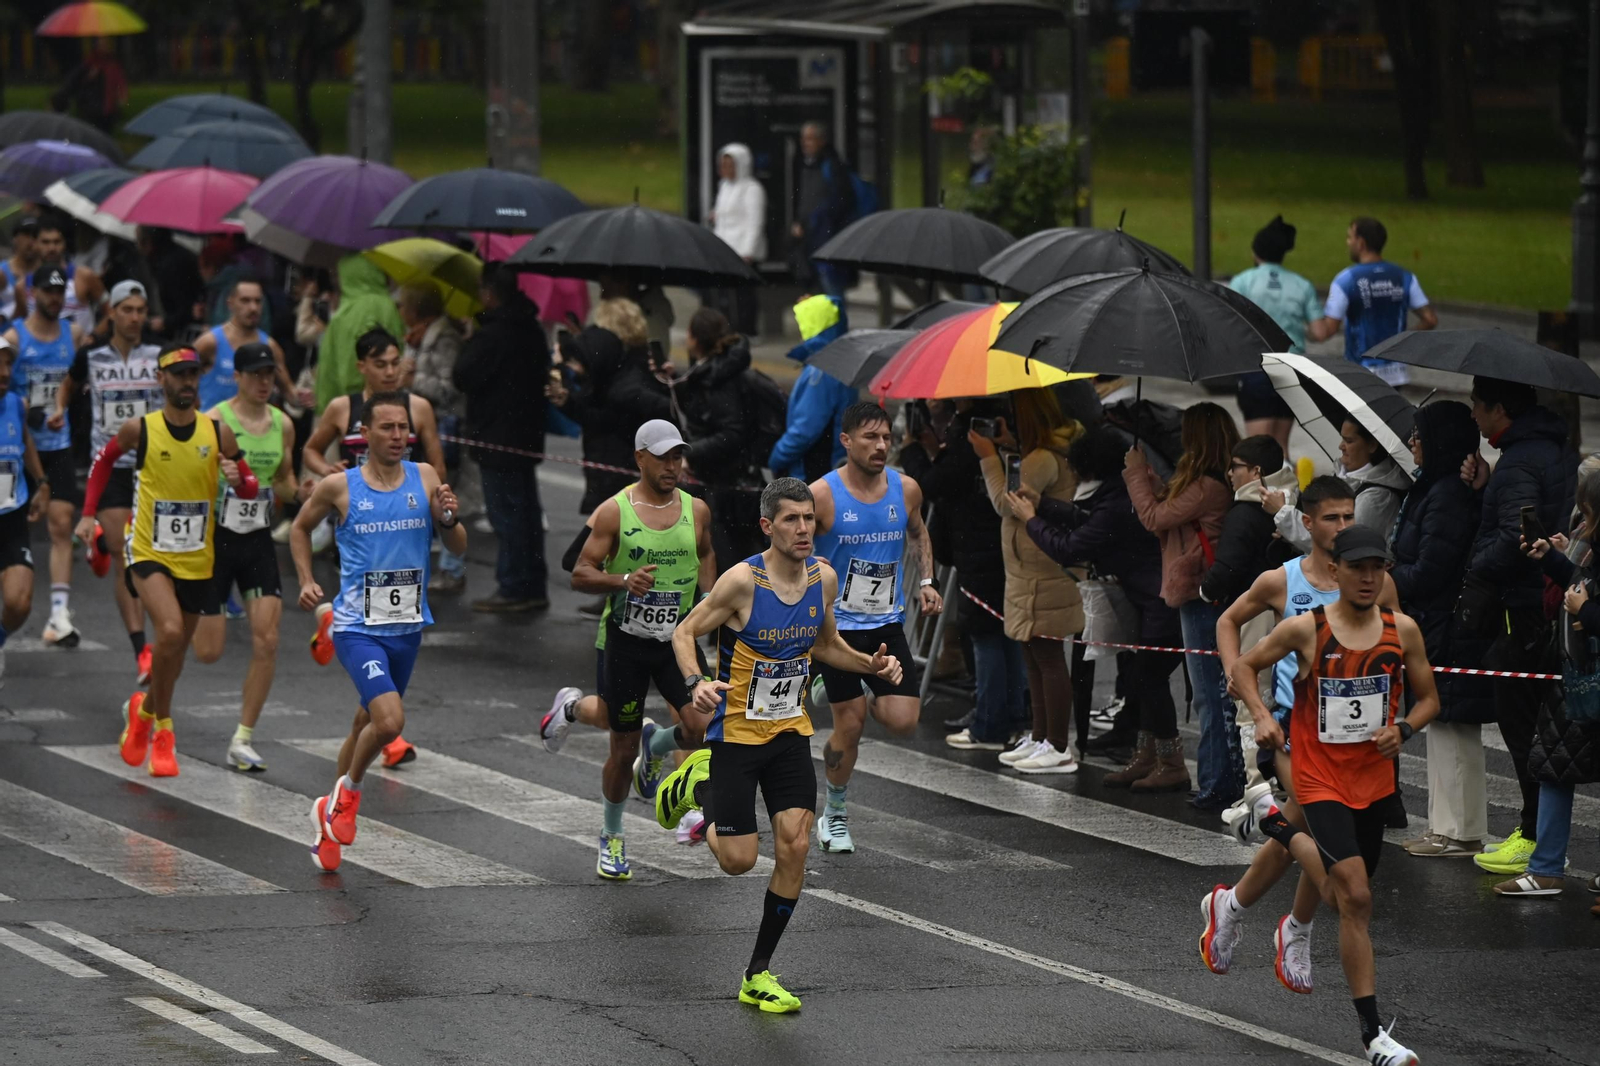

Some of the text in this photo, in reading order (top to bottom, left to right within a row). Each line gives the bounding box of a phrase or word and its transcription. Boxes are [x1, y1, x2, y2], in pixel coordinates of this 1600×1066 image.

[115, 403, 135, 419] 63
[239, 502, 258, 518] 38
[171, 518, 190, 535] 61
[354, 518, 427, 534] TROTASIERRA
[838, 530, 903, 545] TROTASIERRA
[647, 548, 689, 558] Fundación
[647, 558, 677, 567] Unicaja
[871, 580, 882, 596] 7
[390, 588, 401, 606] 6
[1293, 595, 1312, 603] TROPS
[631, 604, 678, 624] 7665
[758, 623, 818, 644] agustinos
[770, 679, 792, 699] 44
[1349, 700, 1362, 720] 3
